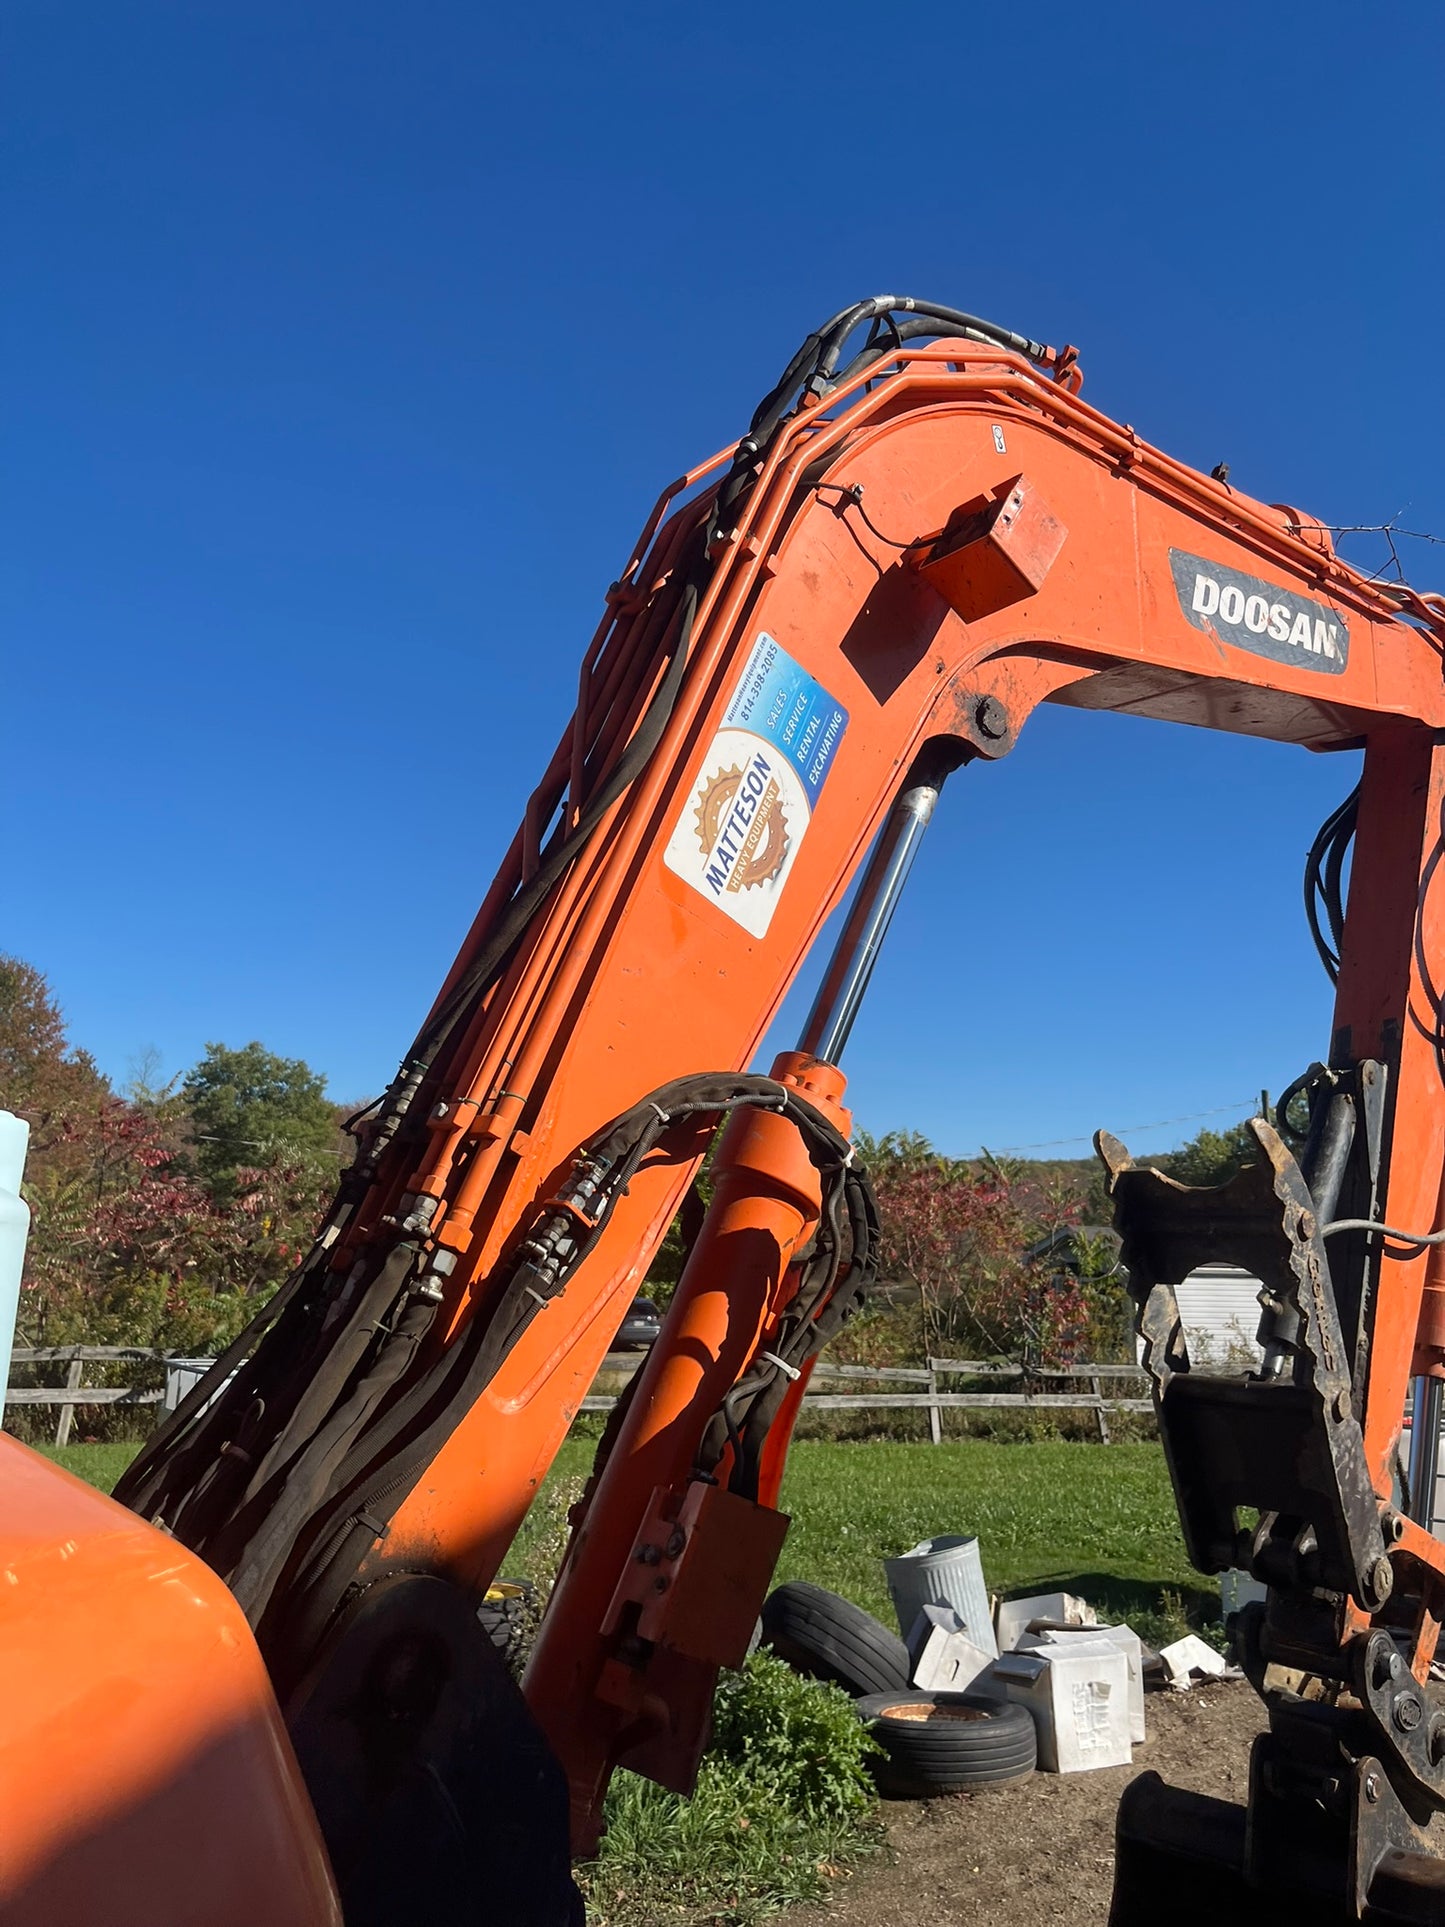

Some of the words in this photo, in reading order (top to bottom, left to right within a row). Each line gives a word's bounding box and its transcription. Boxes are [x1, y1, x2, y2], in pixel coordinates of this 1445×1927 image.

[1192, 573, 1338, 660] DOOSAN
[740, 644, 779, 721] 814-398-2085
[766, 688, 788, 730] SALES
[782, 692, 809, 745] SERVICE
[796, 715, 821, 763] RENTAL
[808, 711, 843, 786] EXCAVATING
[705, 752, 772, 896] MATTESON
[731, 848, 751, 888] HEAVY
[747, 786, 779, 850] EQUIPMENT
